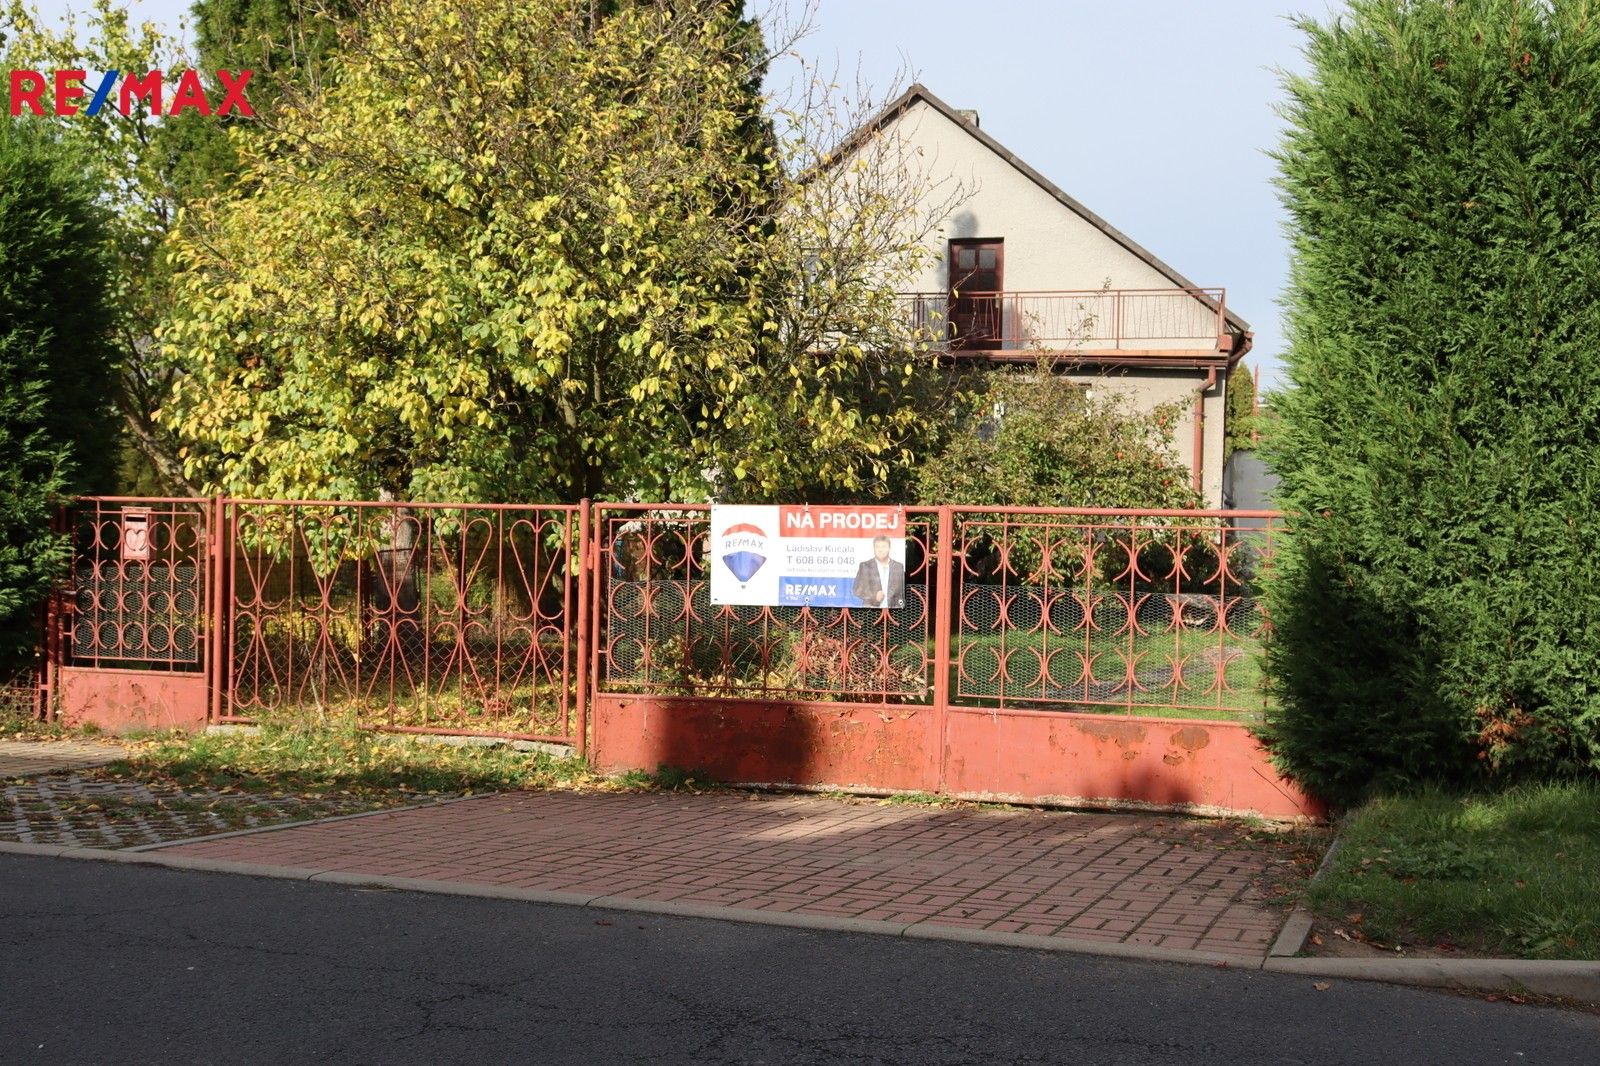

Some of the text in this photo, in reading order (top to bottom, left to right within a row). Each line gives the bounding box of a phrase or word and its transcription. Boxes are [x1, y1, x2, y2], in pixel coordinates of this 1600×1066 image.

[786, 512, 899, 530] NA PRODEJ
[725, 538, 764, 550] RE/MAX
[786, 544, 822, 553] Ladislav
[787, 556, 855, 566] T 608 684 048
[785, 584, 837, 596] RE/MAX
